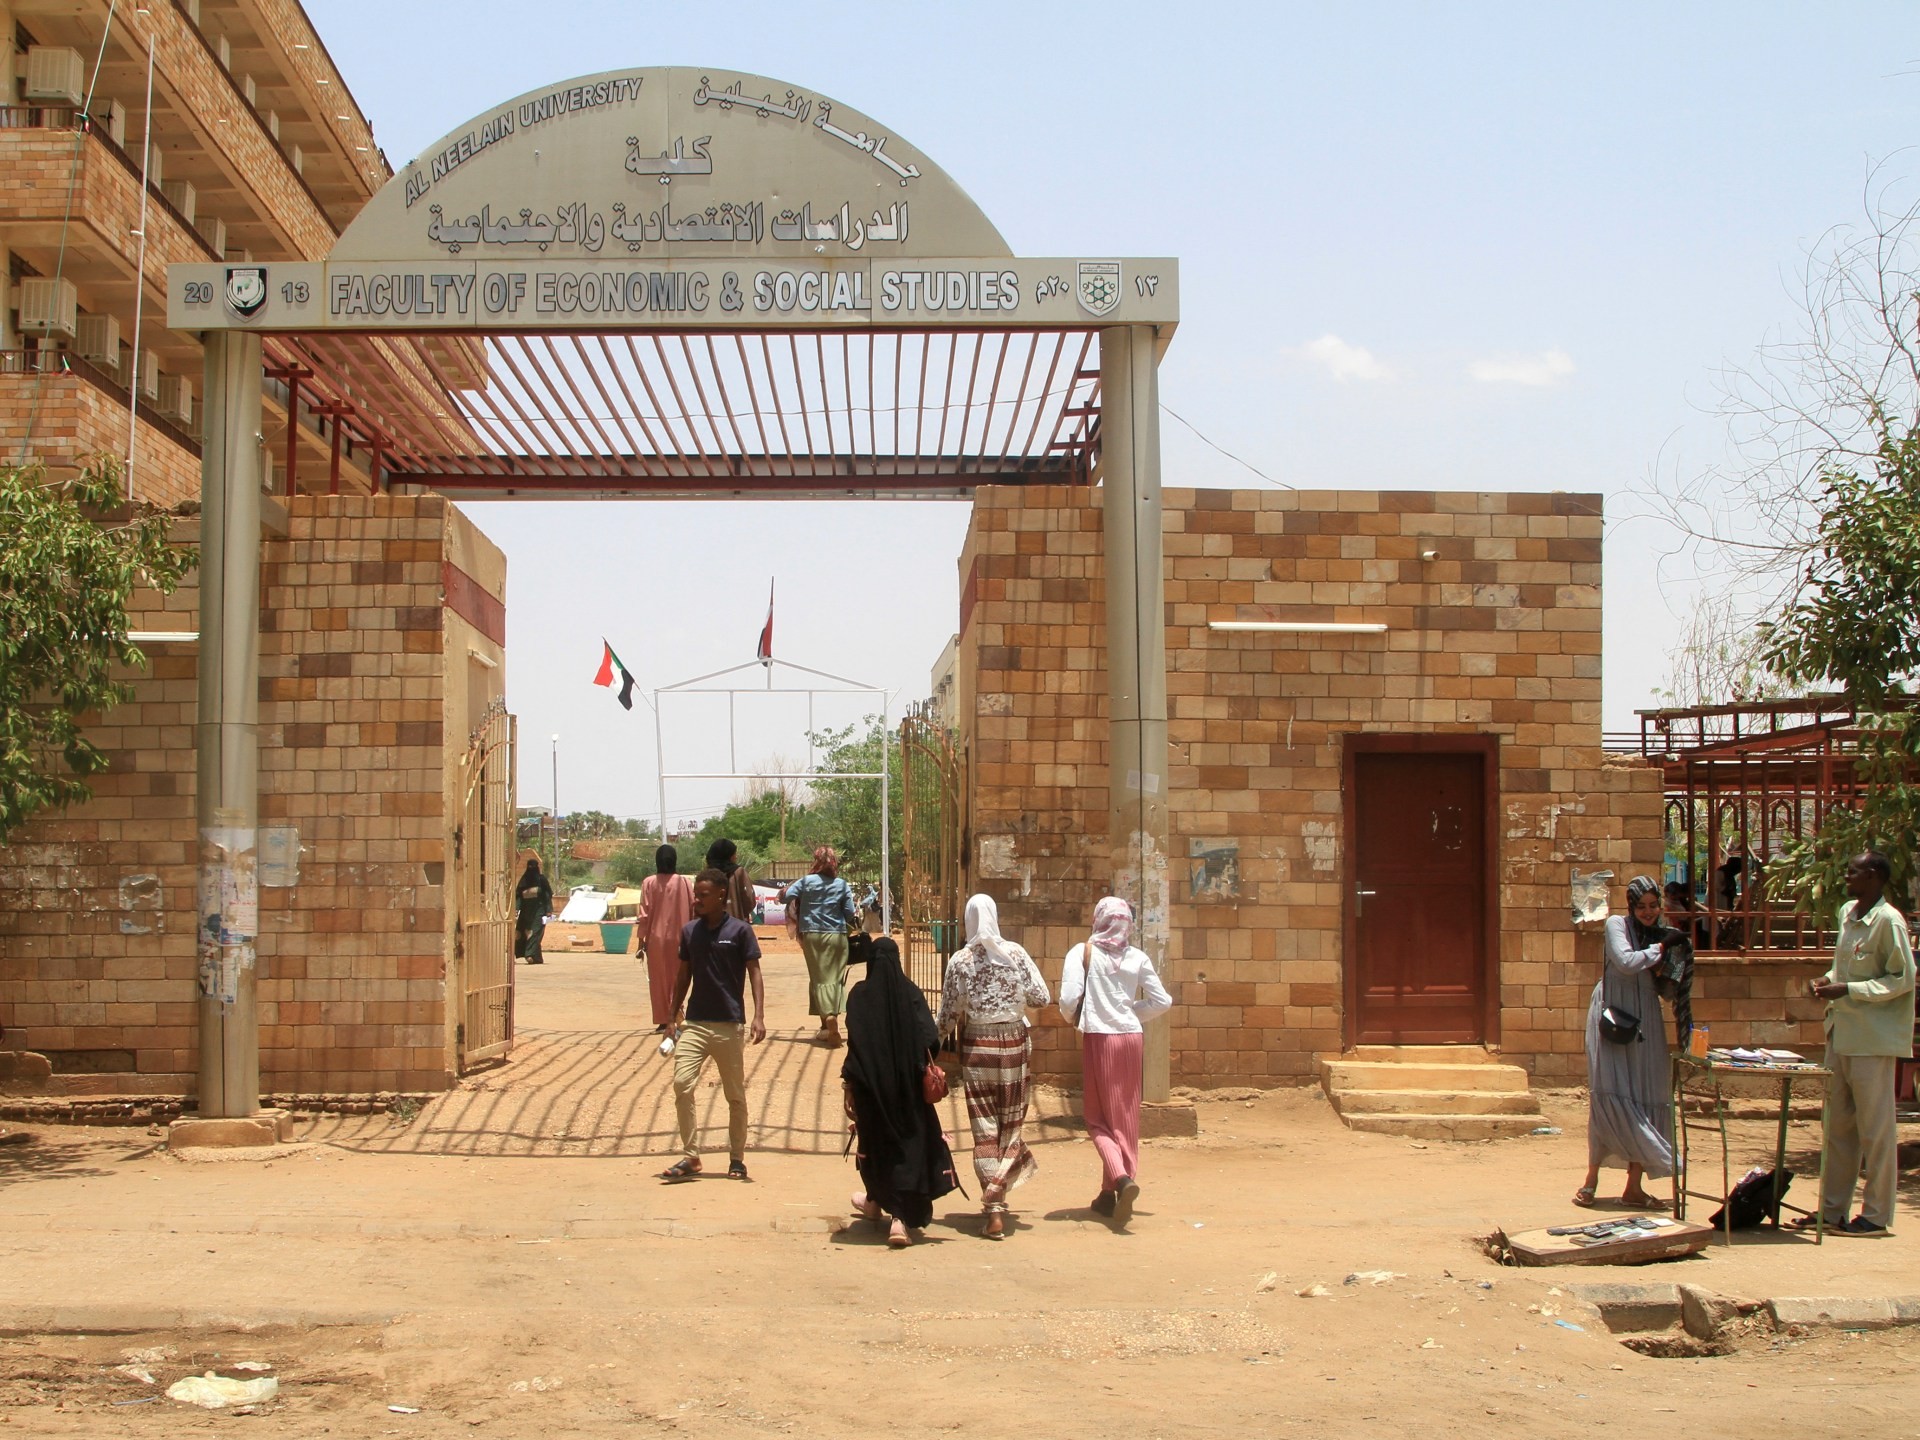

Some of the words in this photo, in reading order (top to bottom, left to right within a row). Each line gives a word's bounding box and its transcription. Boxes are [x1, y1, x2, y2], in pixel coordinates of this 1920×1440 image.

[693, 76, 812, 123] النيلين
[405, 171, 430, 208] AL
[431, 111, 514, 183] NEELAIN
[518, 77, 643, 128] UNIVERSITY
[624, 136, 713, 186] كلية
[813, 100, 922, 188] جامعة
[427, 201, 606, 254] والاجتماعية
[611, 201, 764, 253] الاقتصادية
[771, 201, 908, 251] الدراسات
[184, 282, 214, 304] 20
[281, 281, 310, 303] 13
[330, 274, 476, 315] FACULTY
[482, 273, 527, 313] OF
[535, 271, 710, 313] ECONOMIC
[719, 270, 745, 312] &
[752, 270, 872, 312] SOCIAL
[880, 270, 1020, 311] STUDIES
